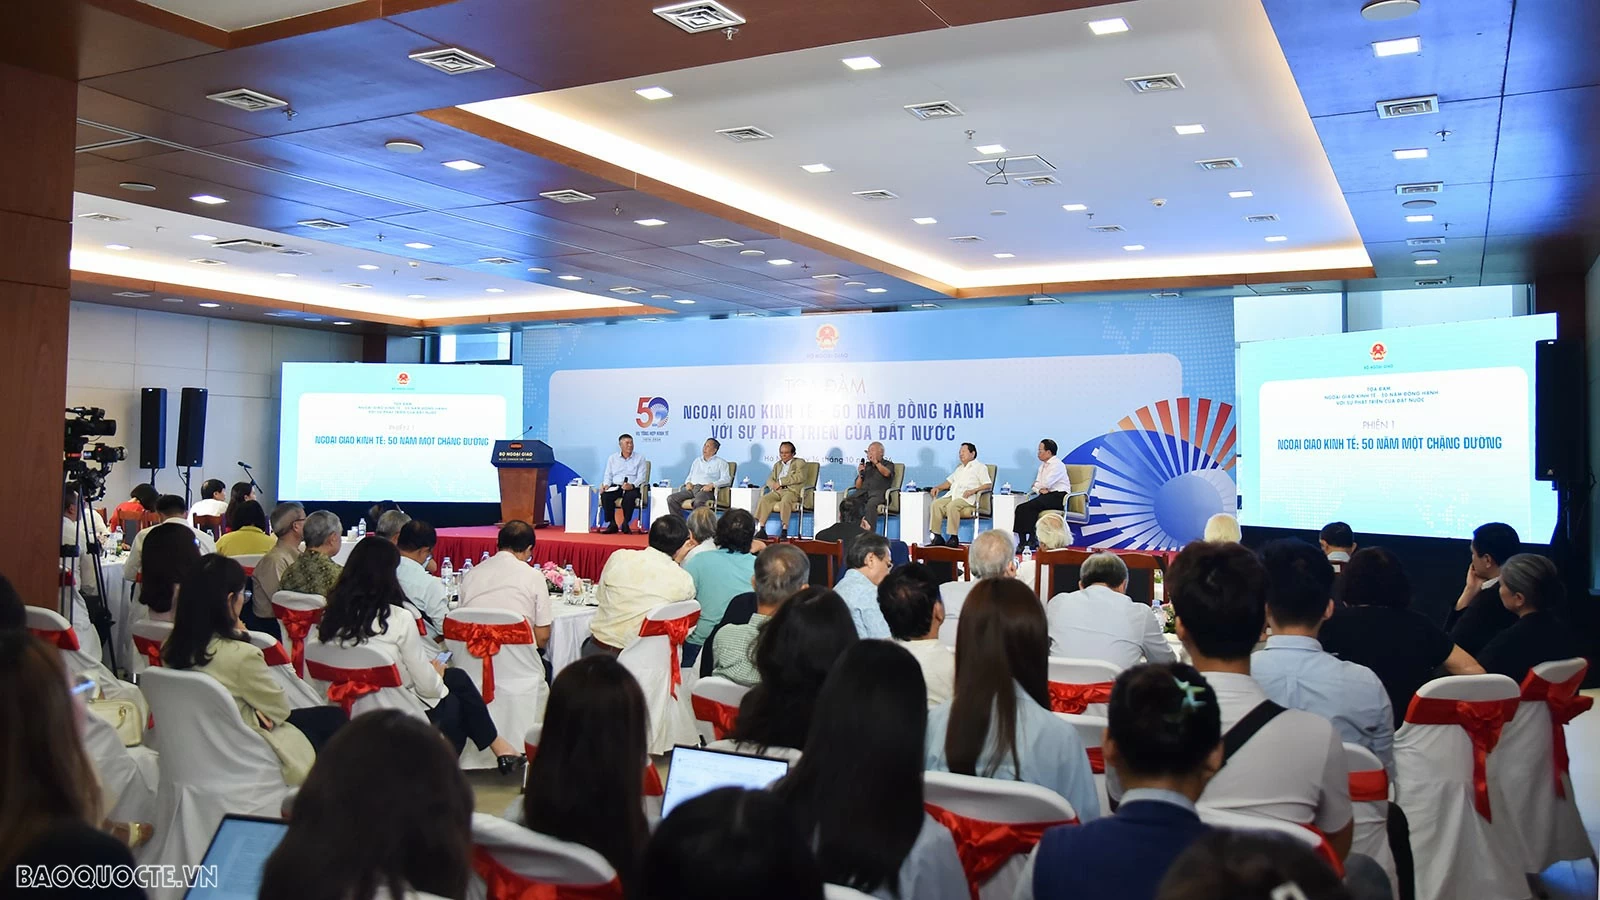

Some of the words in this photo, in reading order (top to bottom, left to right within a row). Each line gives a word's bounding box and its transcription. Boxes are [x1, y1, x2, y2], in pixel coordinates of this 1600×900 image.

[683, 404, 722, 421] NGOẠI
[727, 404, 756, 419] GIAO
[761, 403, 793, 419] KINH
[857, 401, 891, 419] NĂM
[897, 398, 937, 419] ĐỒNG
[943, 400, 985, 419] HÀNH
[388, 436, 398, 445] 50
[711, 421, 733, 440] VỚI
[738, 424, 757, 442] SỰ
[845, 421, 872, 441] CỦA
[878, 420, 906, 441] ĐẤT
[911, 421, 956, 441] NƯỚC
[1278, 439, 1301, 451] NGOẠI
[1304, 438, 1321, 450] GIAO
[1324, 438, 1344, 450] KINH
[1361, 437, 1374, 450] 50
[1376, 436, 1399, 450] NĂM
[1402, 435, 1423, 451] MỘT
[1426, 434, 1460, 452] CHẶNG
